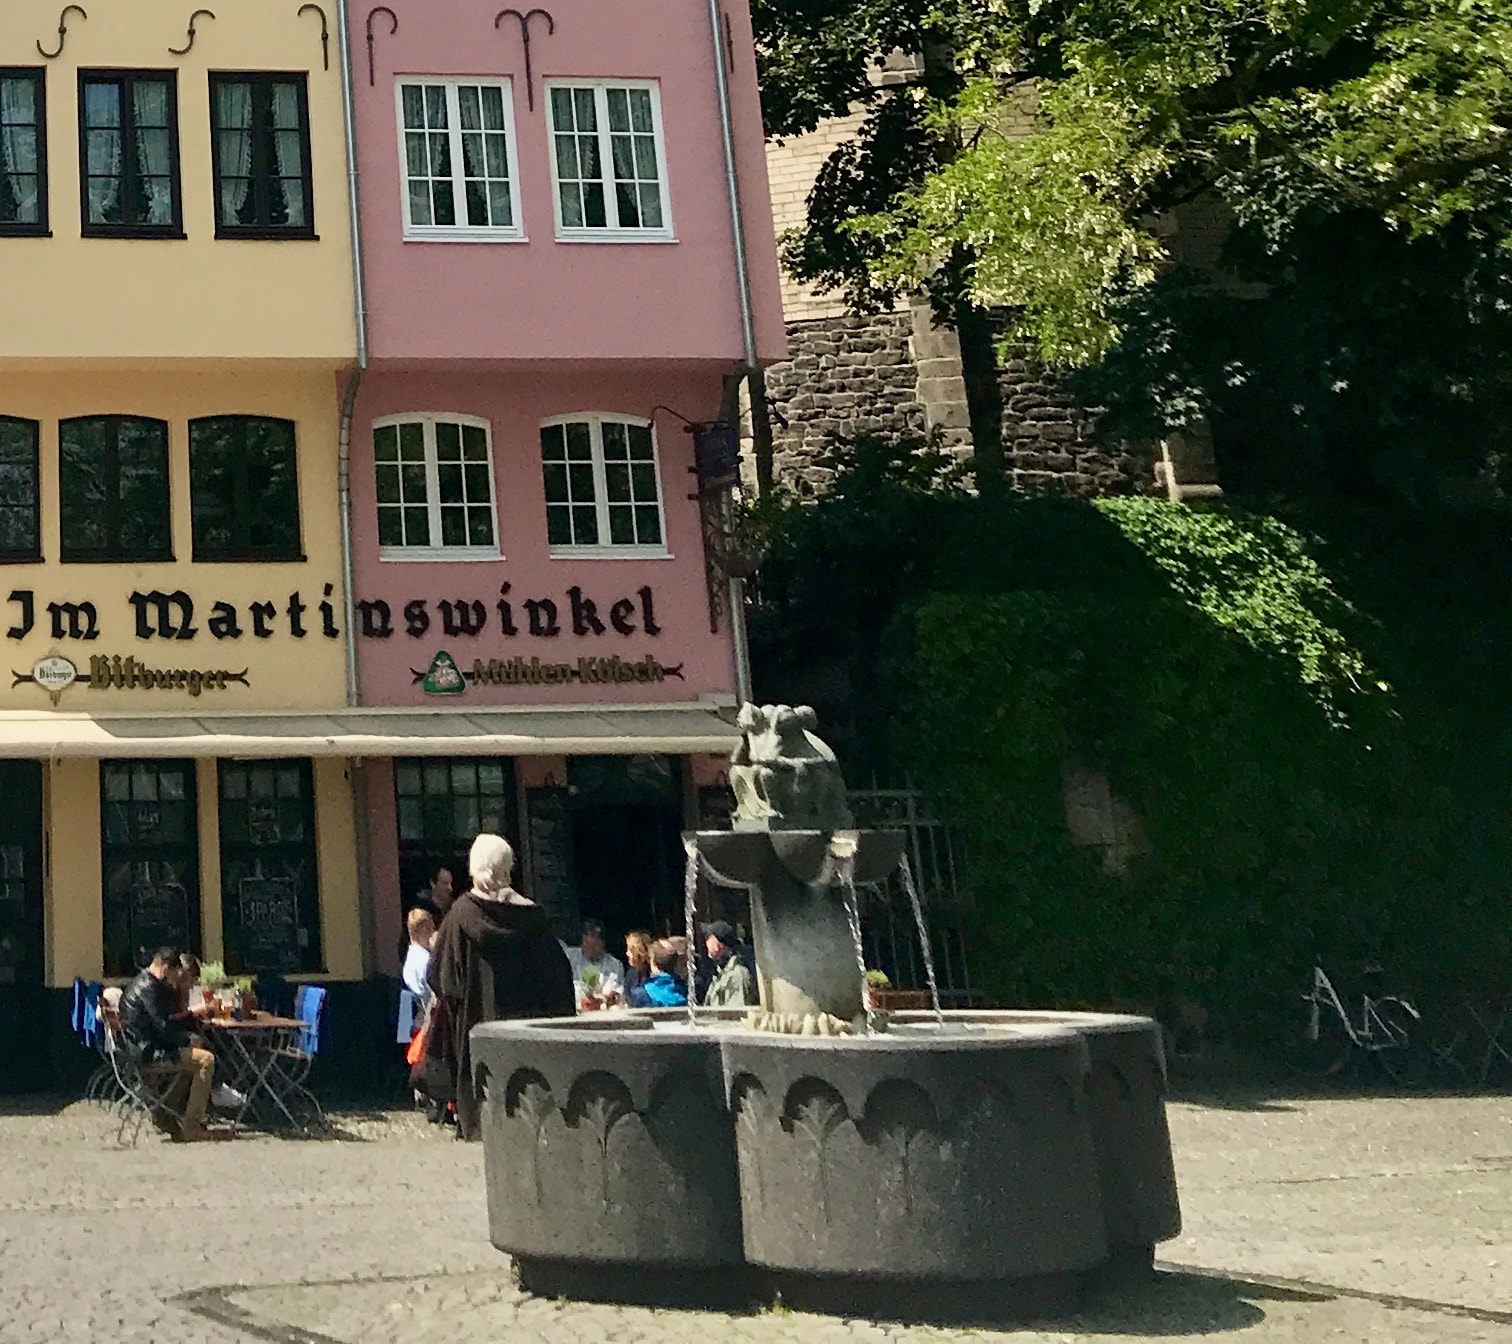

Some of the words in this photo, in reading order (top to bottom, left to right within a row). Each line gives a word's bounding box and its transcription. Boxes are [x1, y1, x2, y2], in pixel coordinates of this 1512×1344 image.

[6, 589, 100, 641] Im
[128, 581, 662, 641] Martinswinkel
[88, 654, 229, 697] Bitburger
